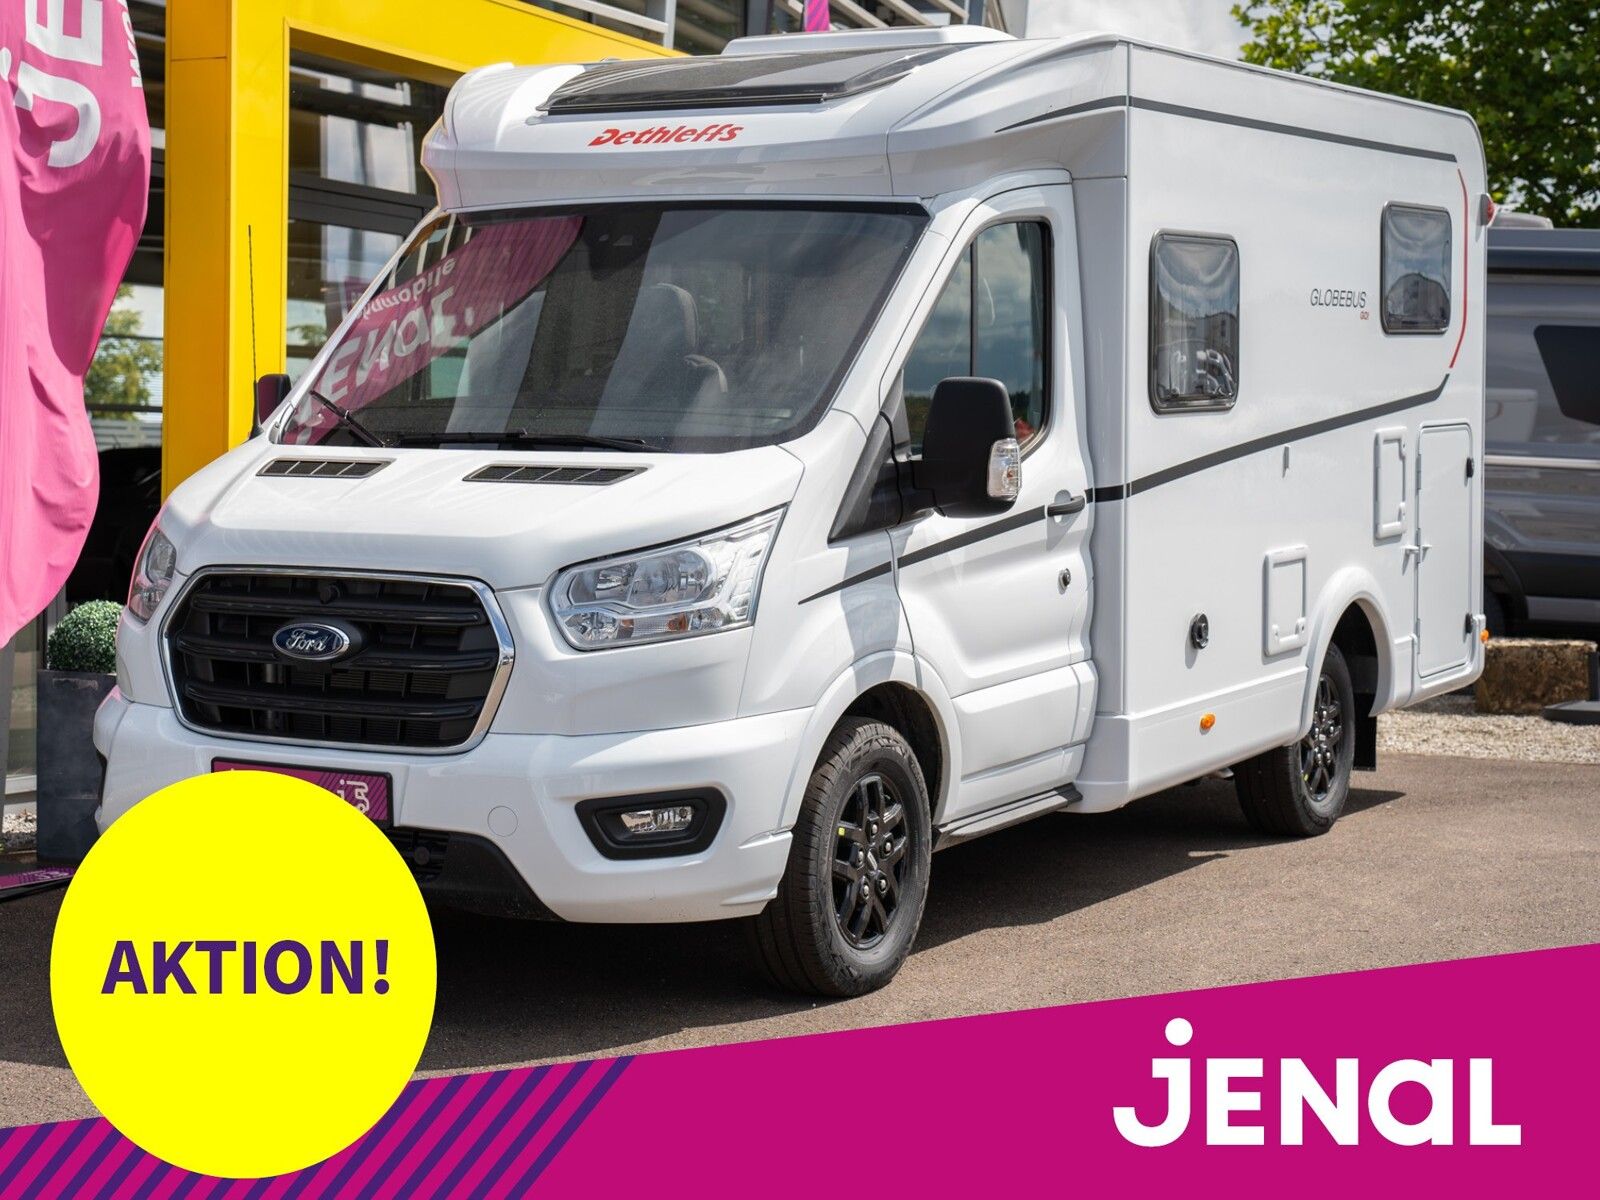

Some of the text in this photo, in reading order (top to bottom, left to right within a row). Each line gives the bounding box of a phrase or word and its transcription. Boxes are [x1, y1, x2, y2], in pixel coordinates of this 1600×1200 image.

[587, 123, 744, 147] Dethleffs
[1310, 288, 1367, 308] GLOBEBUS
[286, 628, 330, 652] Ford
